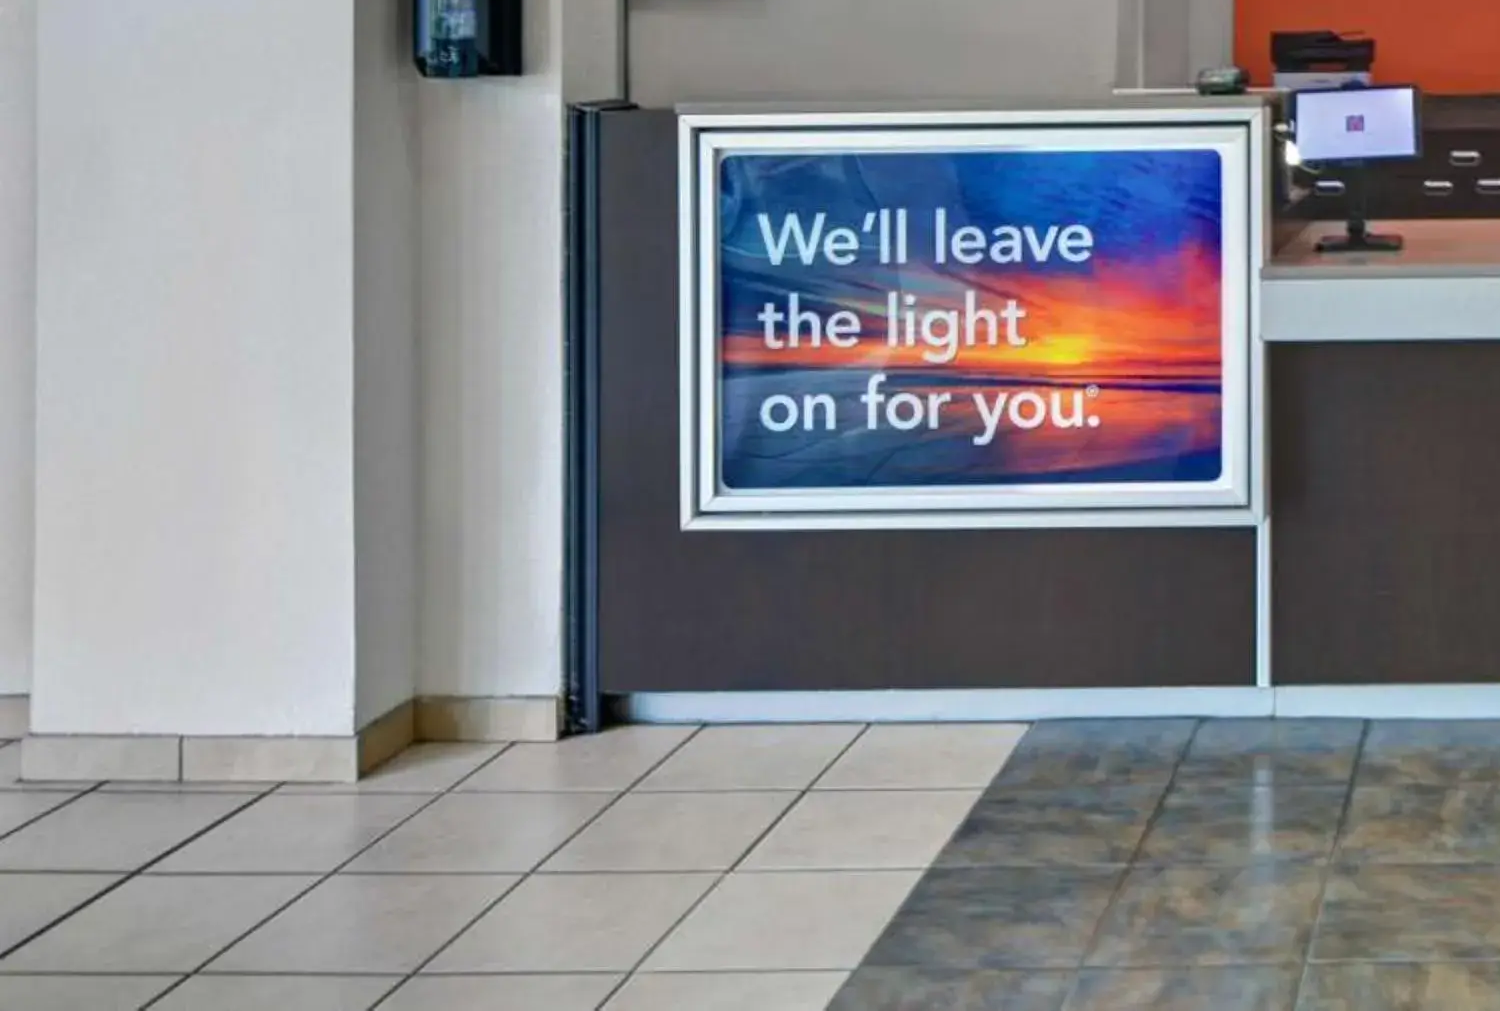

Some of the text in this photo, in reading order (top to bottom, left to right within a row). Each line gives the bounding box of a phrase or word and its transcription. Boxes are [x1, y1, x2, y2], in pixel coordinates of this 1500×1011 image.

[757, 207, 1094, 266] We'll leave
[758, 290, 1028, 364] the light
[759, 392, 836, 432] on
[861, 374, 951, 430] for
